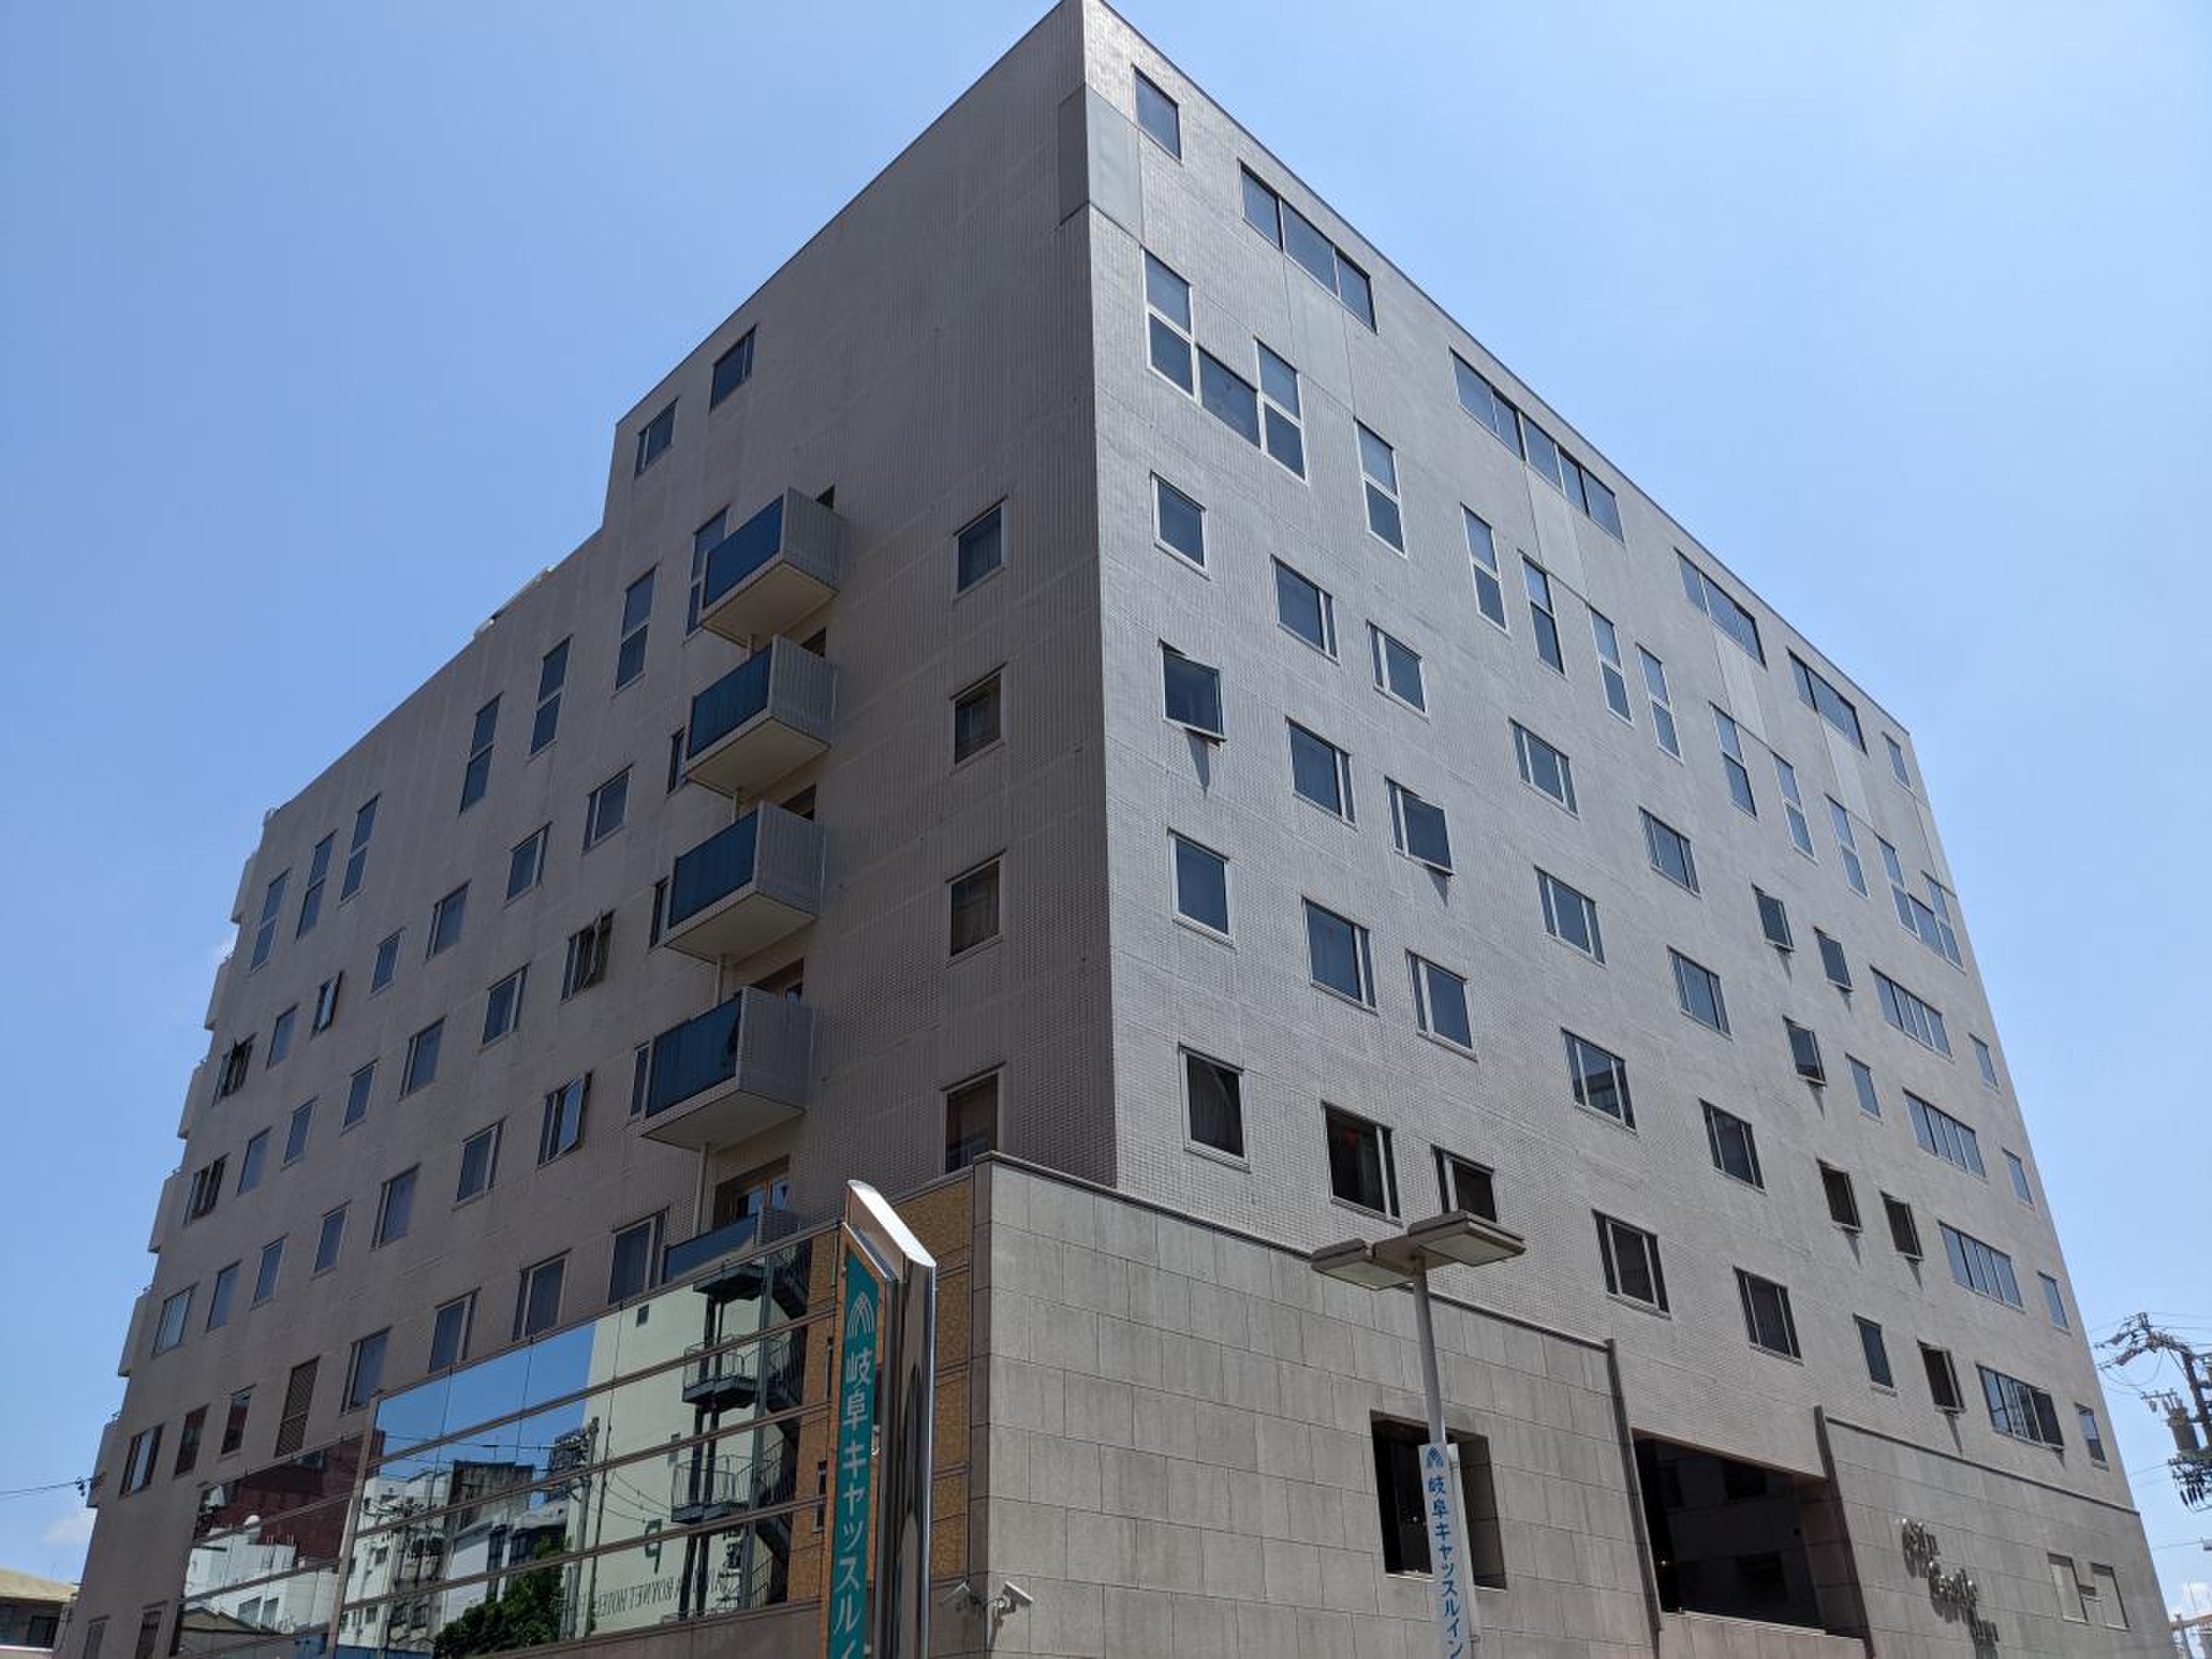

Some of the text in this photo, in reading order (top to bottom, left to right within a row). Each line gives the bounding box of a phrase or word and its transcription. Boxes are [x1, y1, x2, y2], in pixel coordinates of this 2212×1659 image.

[1428, 1475, 1463, 1658] 岐阜キャッスルイン
